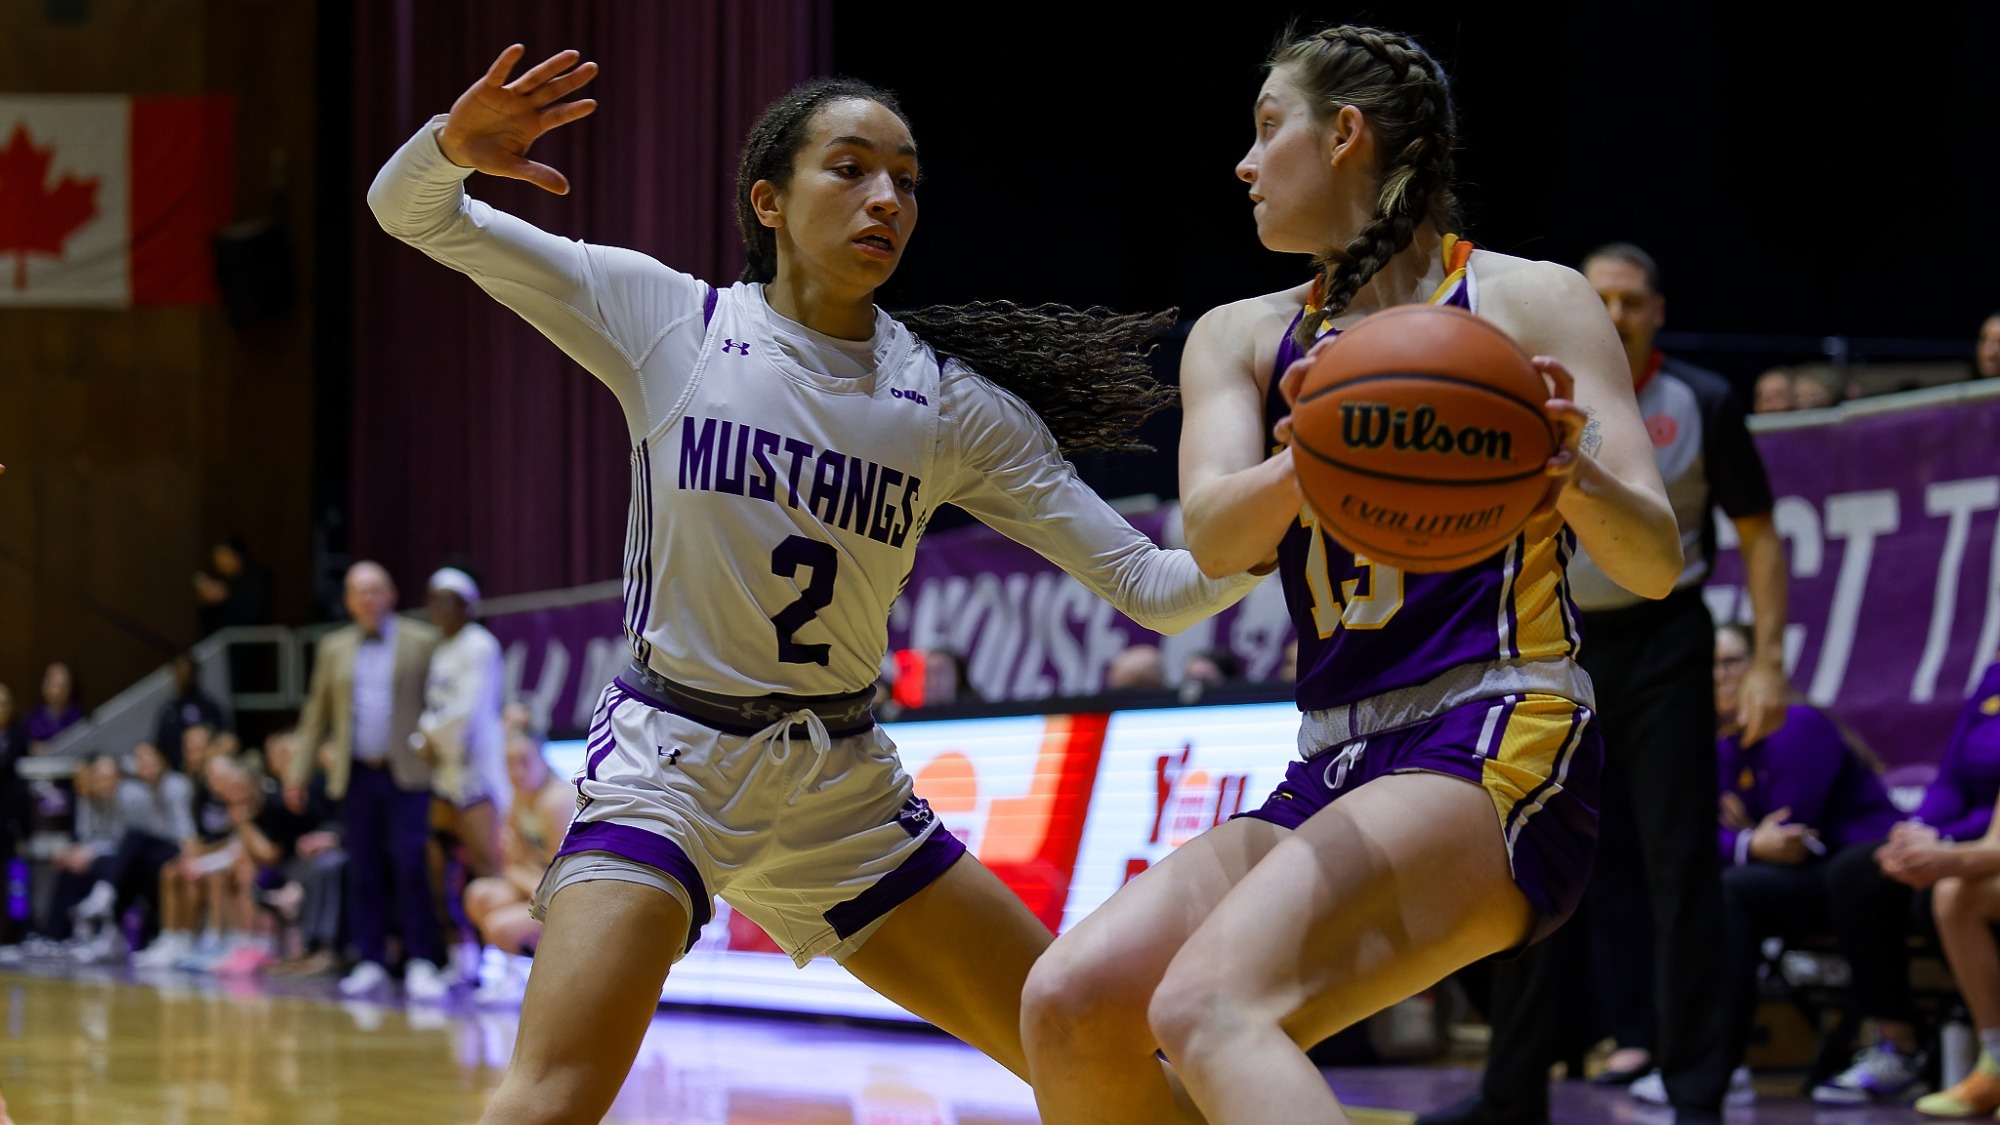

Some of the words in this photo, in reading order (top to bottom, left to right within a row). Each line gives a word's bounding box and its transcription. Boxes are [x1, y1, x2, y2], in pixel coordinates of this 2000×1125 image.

[1339, 401, 1512, 462] Wilson
[678, 415, 922, 549] MUSTANGS
[1341, 494, 1506, 538] EVOLUTION
[771, 533, 838, 667] 2
